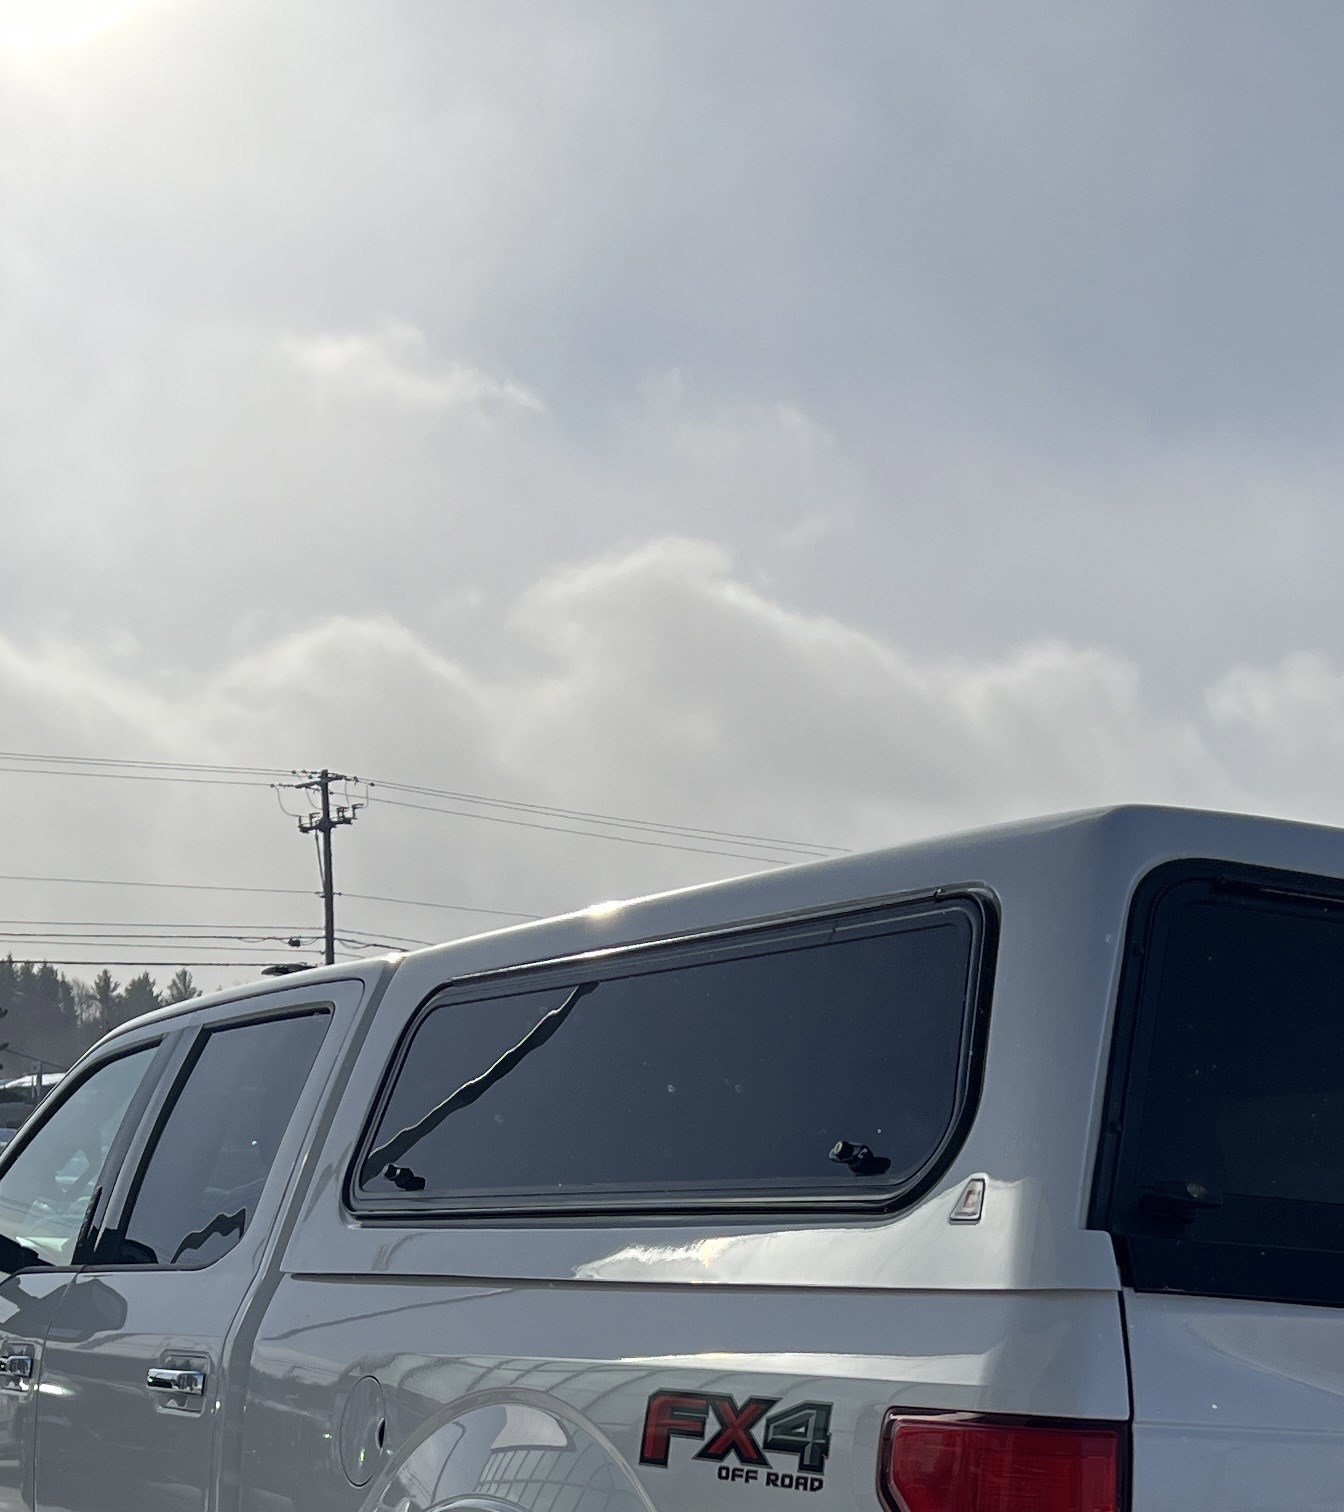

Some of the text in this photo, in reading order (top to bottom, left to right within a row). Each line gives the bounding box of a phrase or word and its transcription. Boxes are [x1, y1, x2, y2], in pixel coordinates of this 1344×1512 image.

[639, 1387, 834, 1475] FX4
[717, 1464, 824, 1492] OFF ROAD
